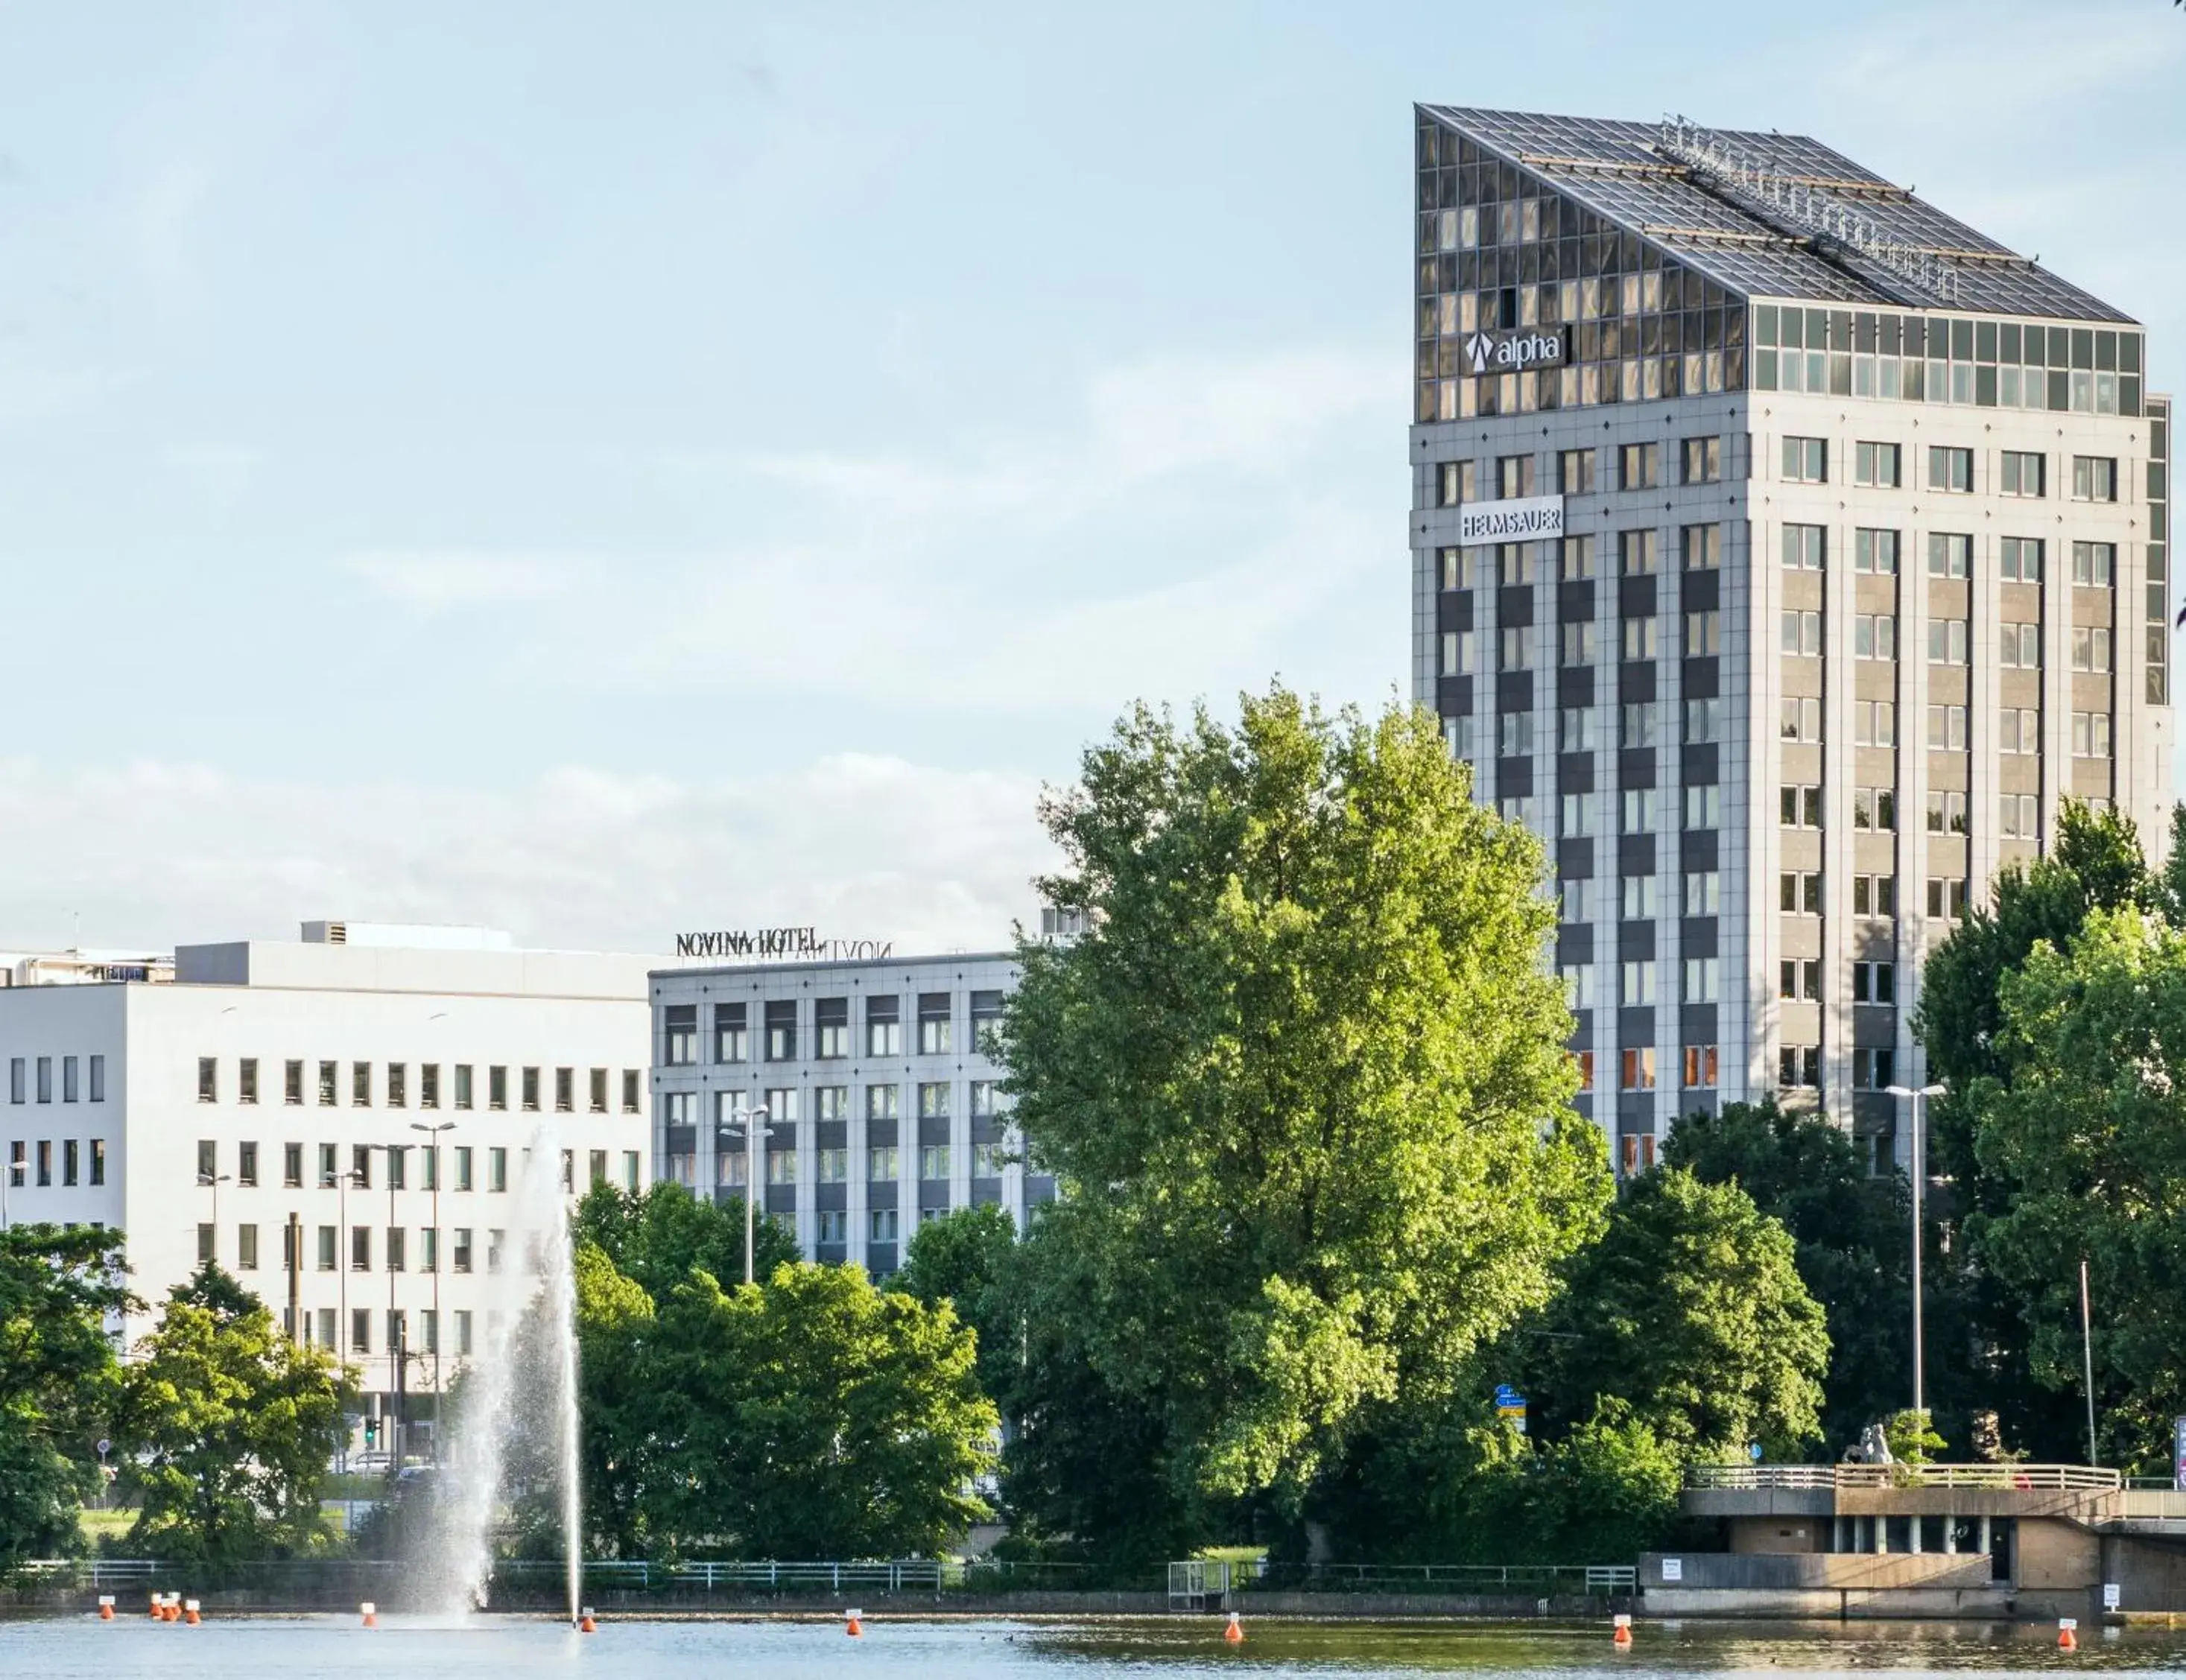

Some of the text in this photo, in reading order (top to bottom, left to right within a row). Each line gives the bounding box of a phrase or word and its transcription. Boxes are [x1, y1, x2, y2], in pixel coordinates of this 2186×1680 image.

[1498, 333, 1560, 370] alpha
[1463, 508, 1561, 537] HELMSAUER
[676, 931, 753, 957] NOVINA
[758, 927, 822, 954] HOTEL
